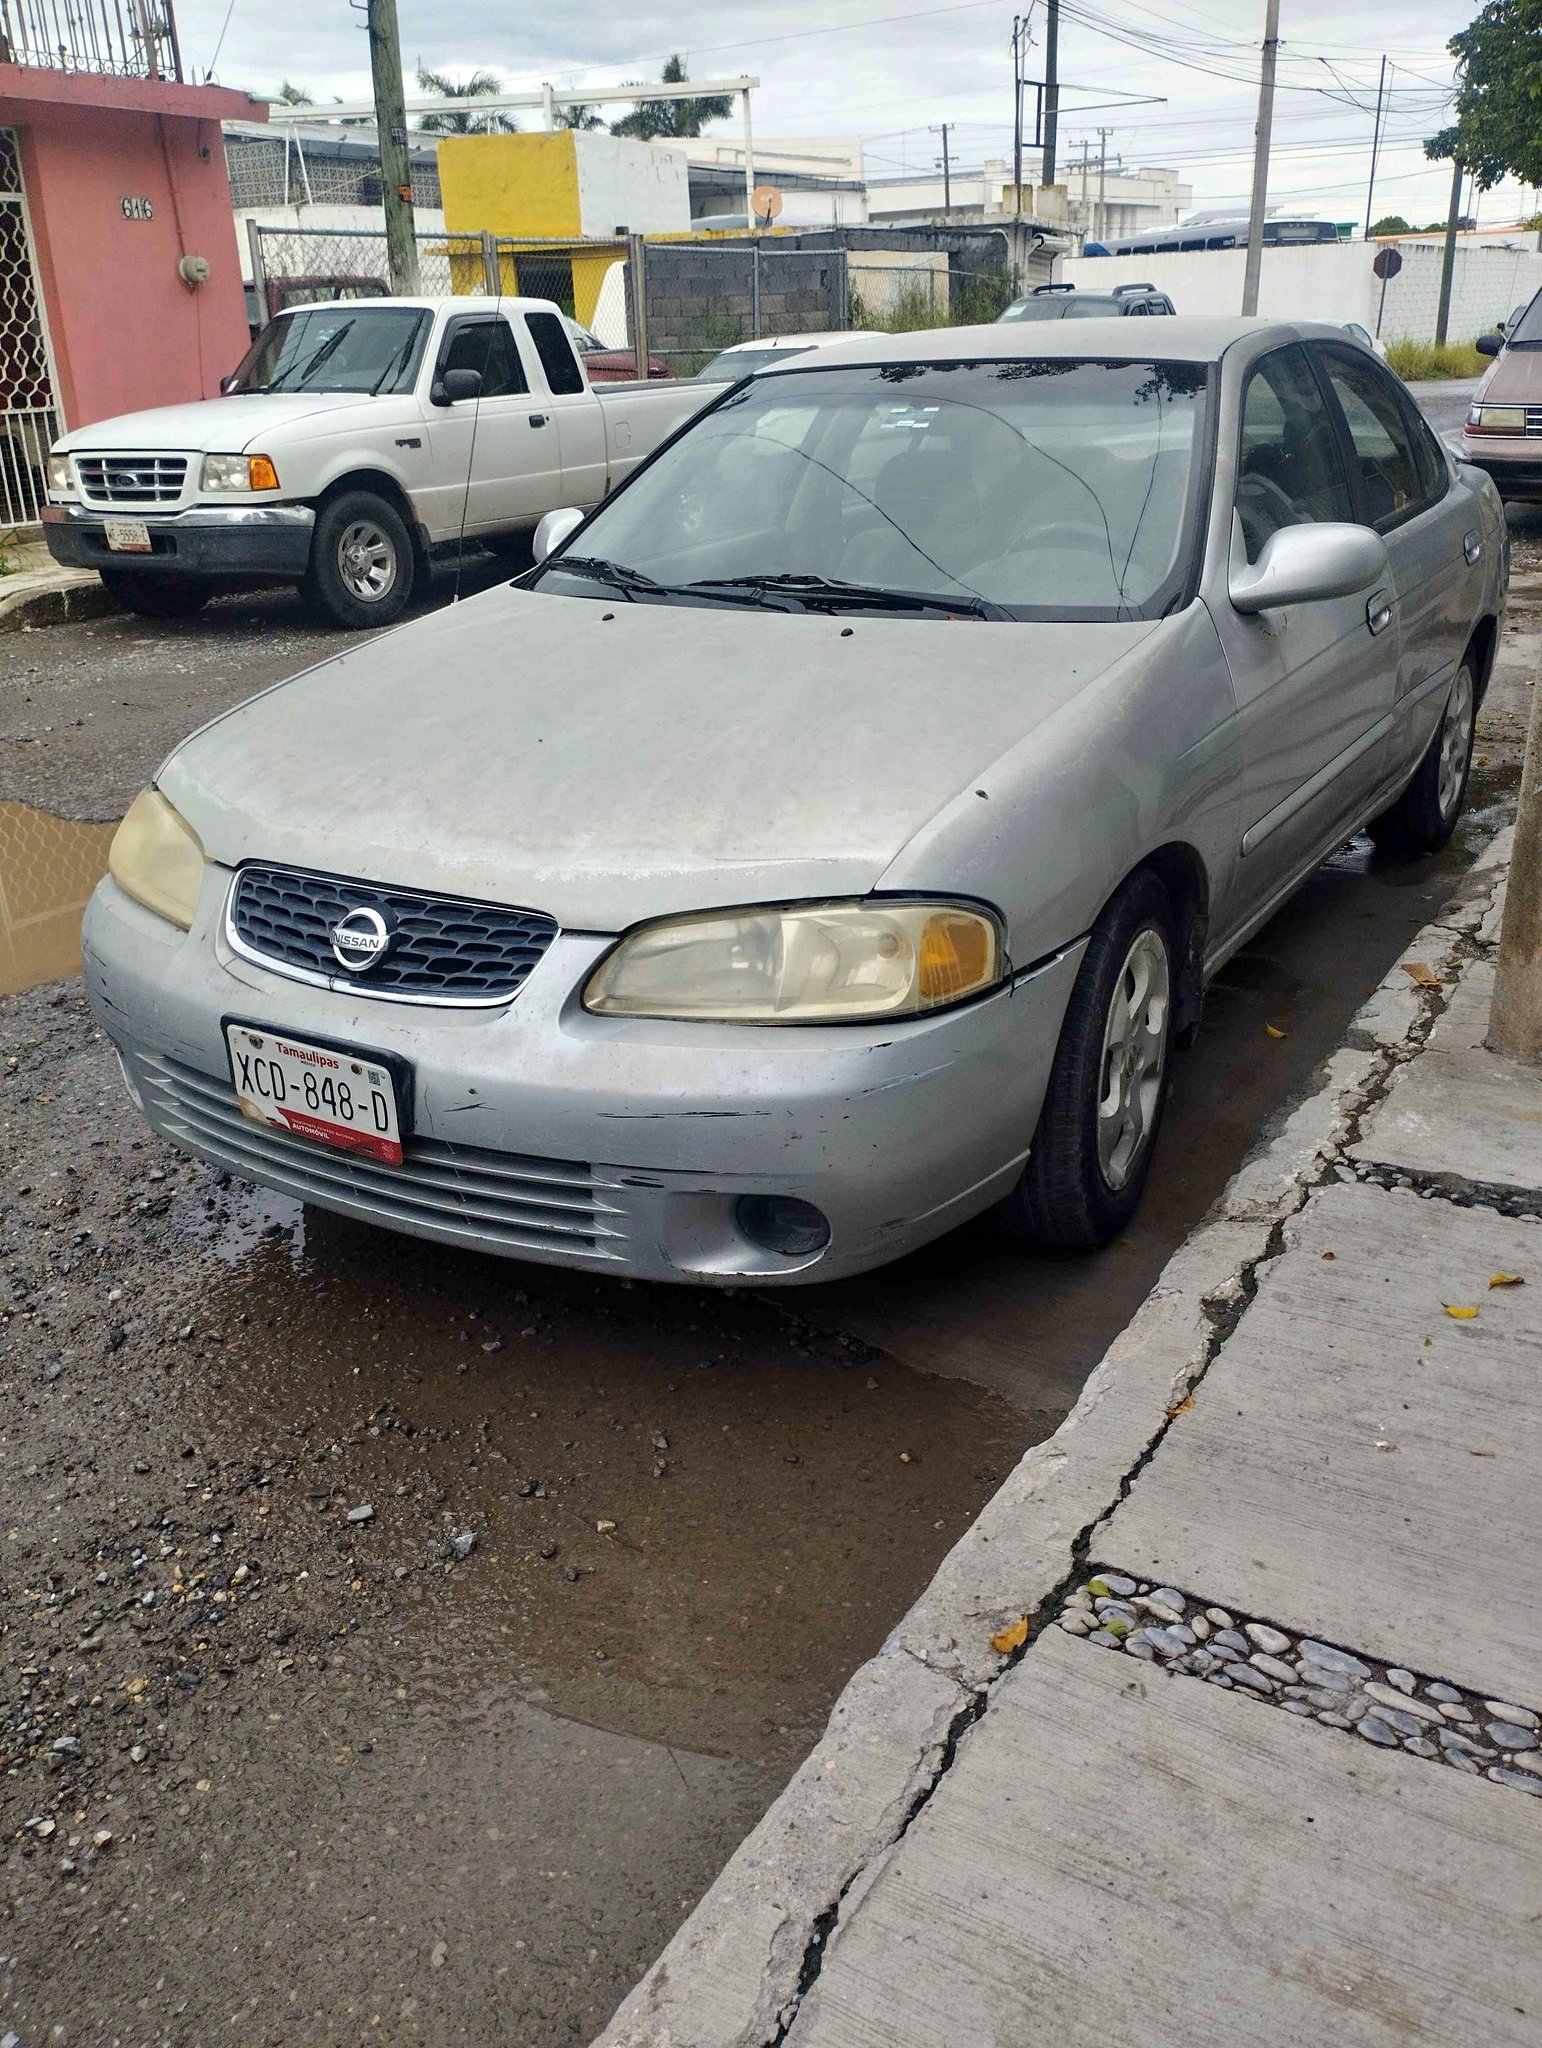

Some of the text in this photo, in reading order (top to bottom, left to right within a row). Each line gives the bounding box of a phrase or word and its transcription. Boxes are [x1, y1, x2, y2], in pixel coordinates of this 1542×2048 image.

[122, 197, 152, 219] 616
[332, 933, 380, 949] NISSAN
[275, 1041, 340, 1069] Tamaulipas
[236, 1051, 389, 1132] XCD-848-D
[292, 1122, 330, 1139] AUTOMÓVIL
